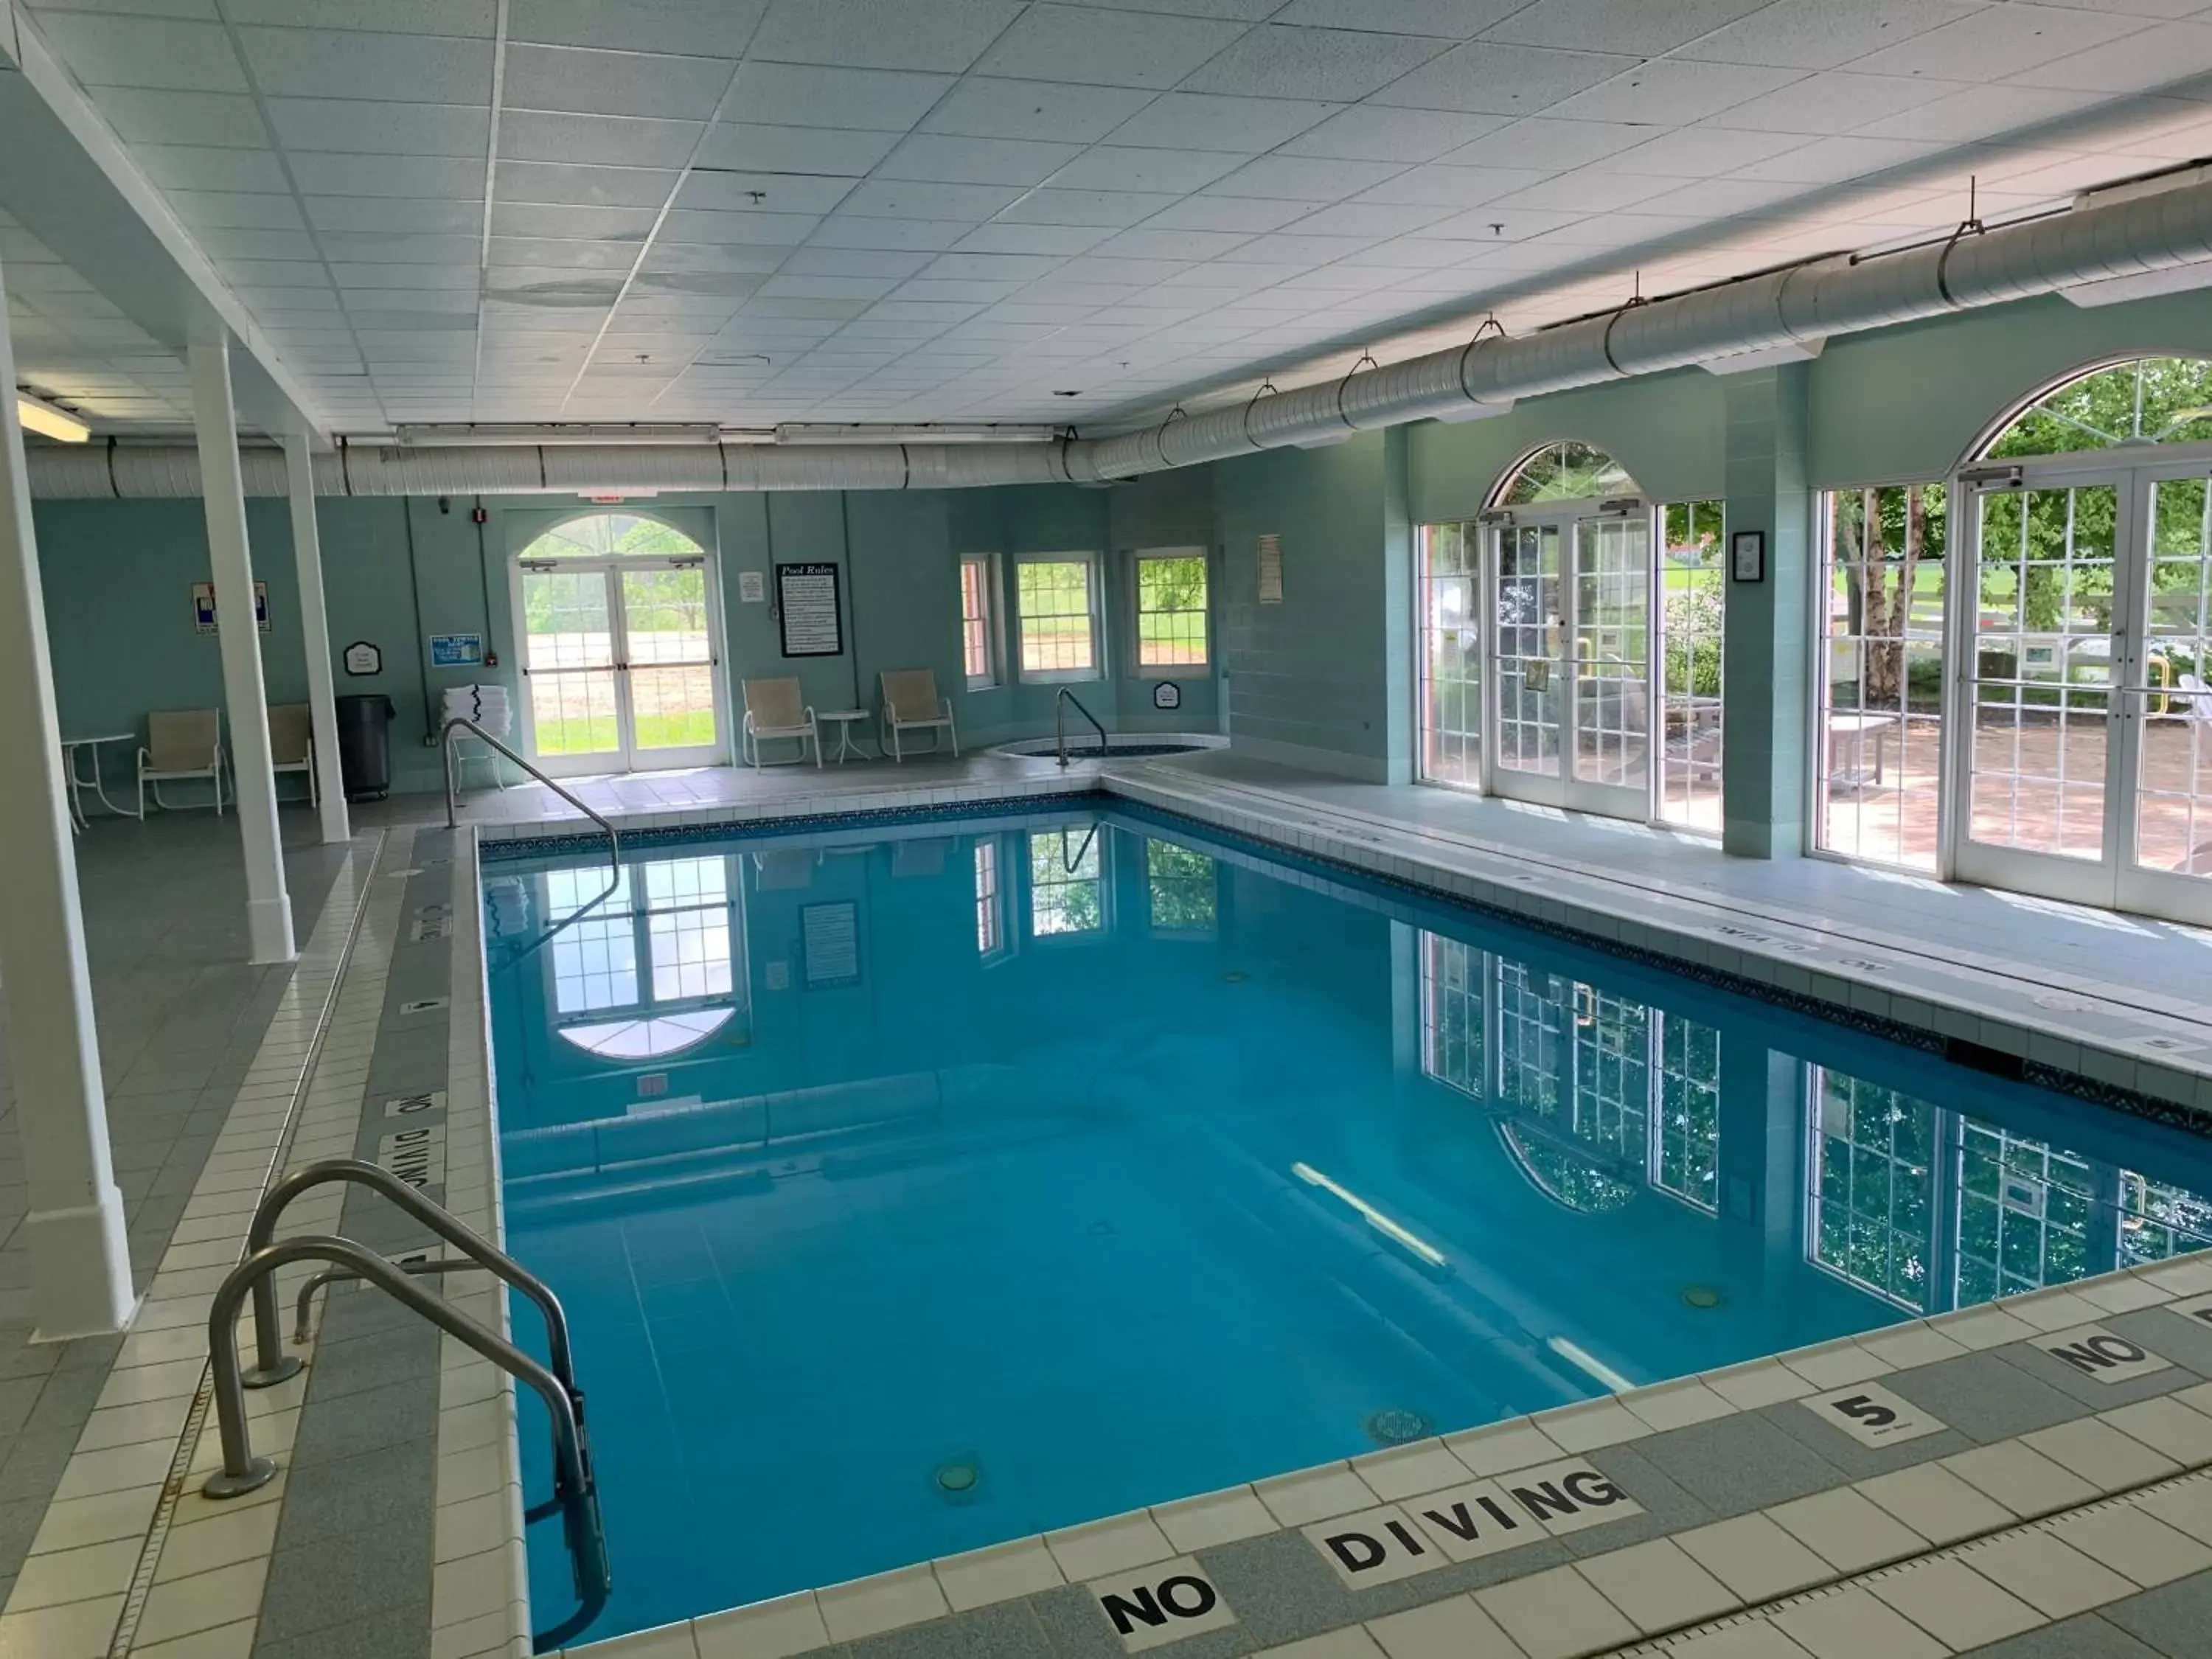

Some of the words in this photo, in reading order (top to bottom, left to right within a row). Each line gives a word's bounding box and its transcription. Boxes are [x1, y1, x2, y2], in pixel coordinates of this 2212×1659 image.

[782, 566, 804, 575] Pool
[807, 566, 834, 575] Rules
[398, 1093, 432, 1113] NO
[2048, 1335, 2146, 1374] NO
[1830, 1394, 1896, 1427] 5
[1099, 1575, 1217, 1635] NO
[1324, 1471, 1629, 1573] DIVING
